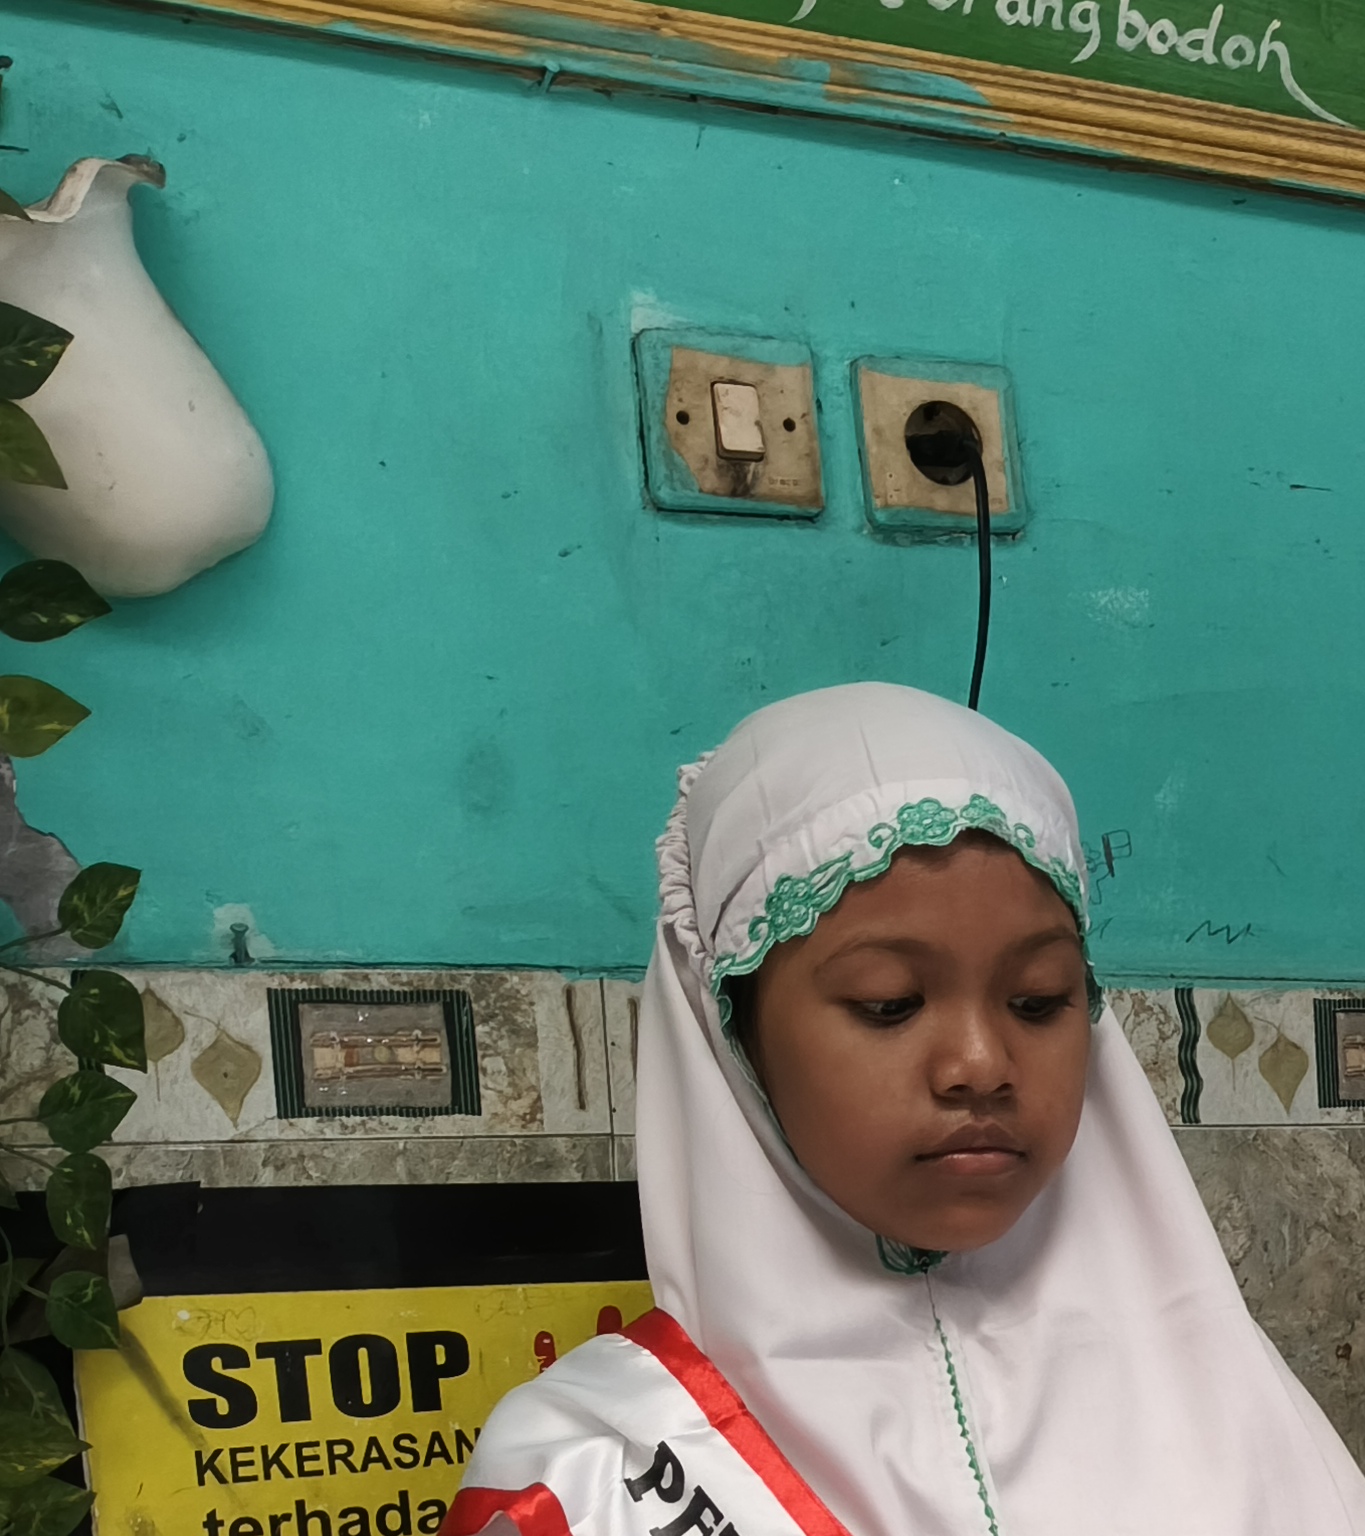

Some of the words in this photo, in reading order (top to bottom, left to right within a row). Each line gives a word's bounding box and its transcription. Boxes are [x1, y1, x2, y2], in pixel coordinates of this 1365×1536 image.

[1117, 0, 1354, 128] bodoh
[182, 1330, 470, 1430] STOP
[194, 1427, 482, 1487] KEKERASAN
